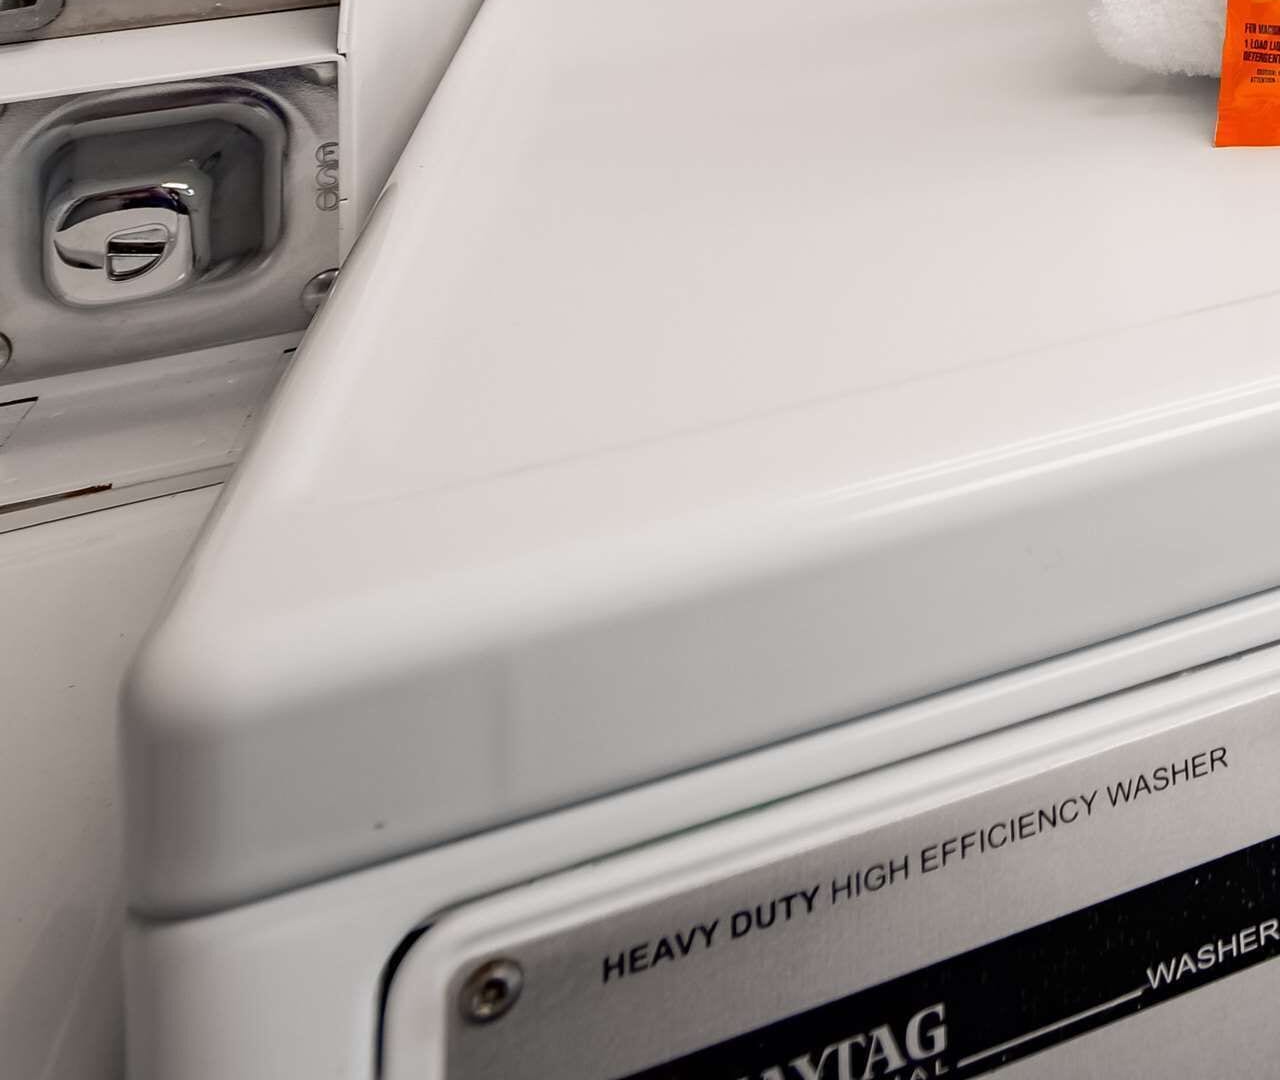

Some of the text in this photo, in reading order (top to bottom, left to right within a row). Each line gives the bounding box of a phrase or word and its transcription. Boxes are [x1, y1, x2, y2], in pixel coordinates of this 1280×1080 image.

[1250, 39, 1268, 50] LOAD
[601, 746, 1231, 985] HEAVY DUTY HIGH EFFICIENCY WASHER
[735, 1001, 948, 1080] YTAG
